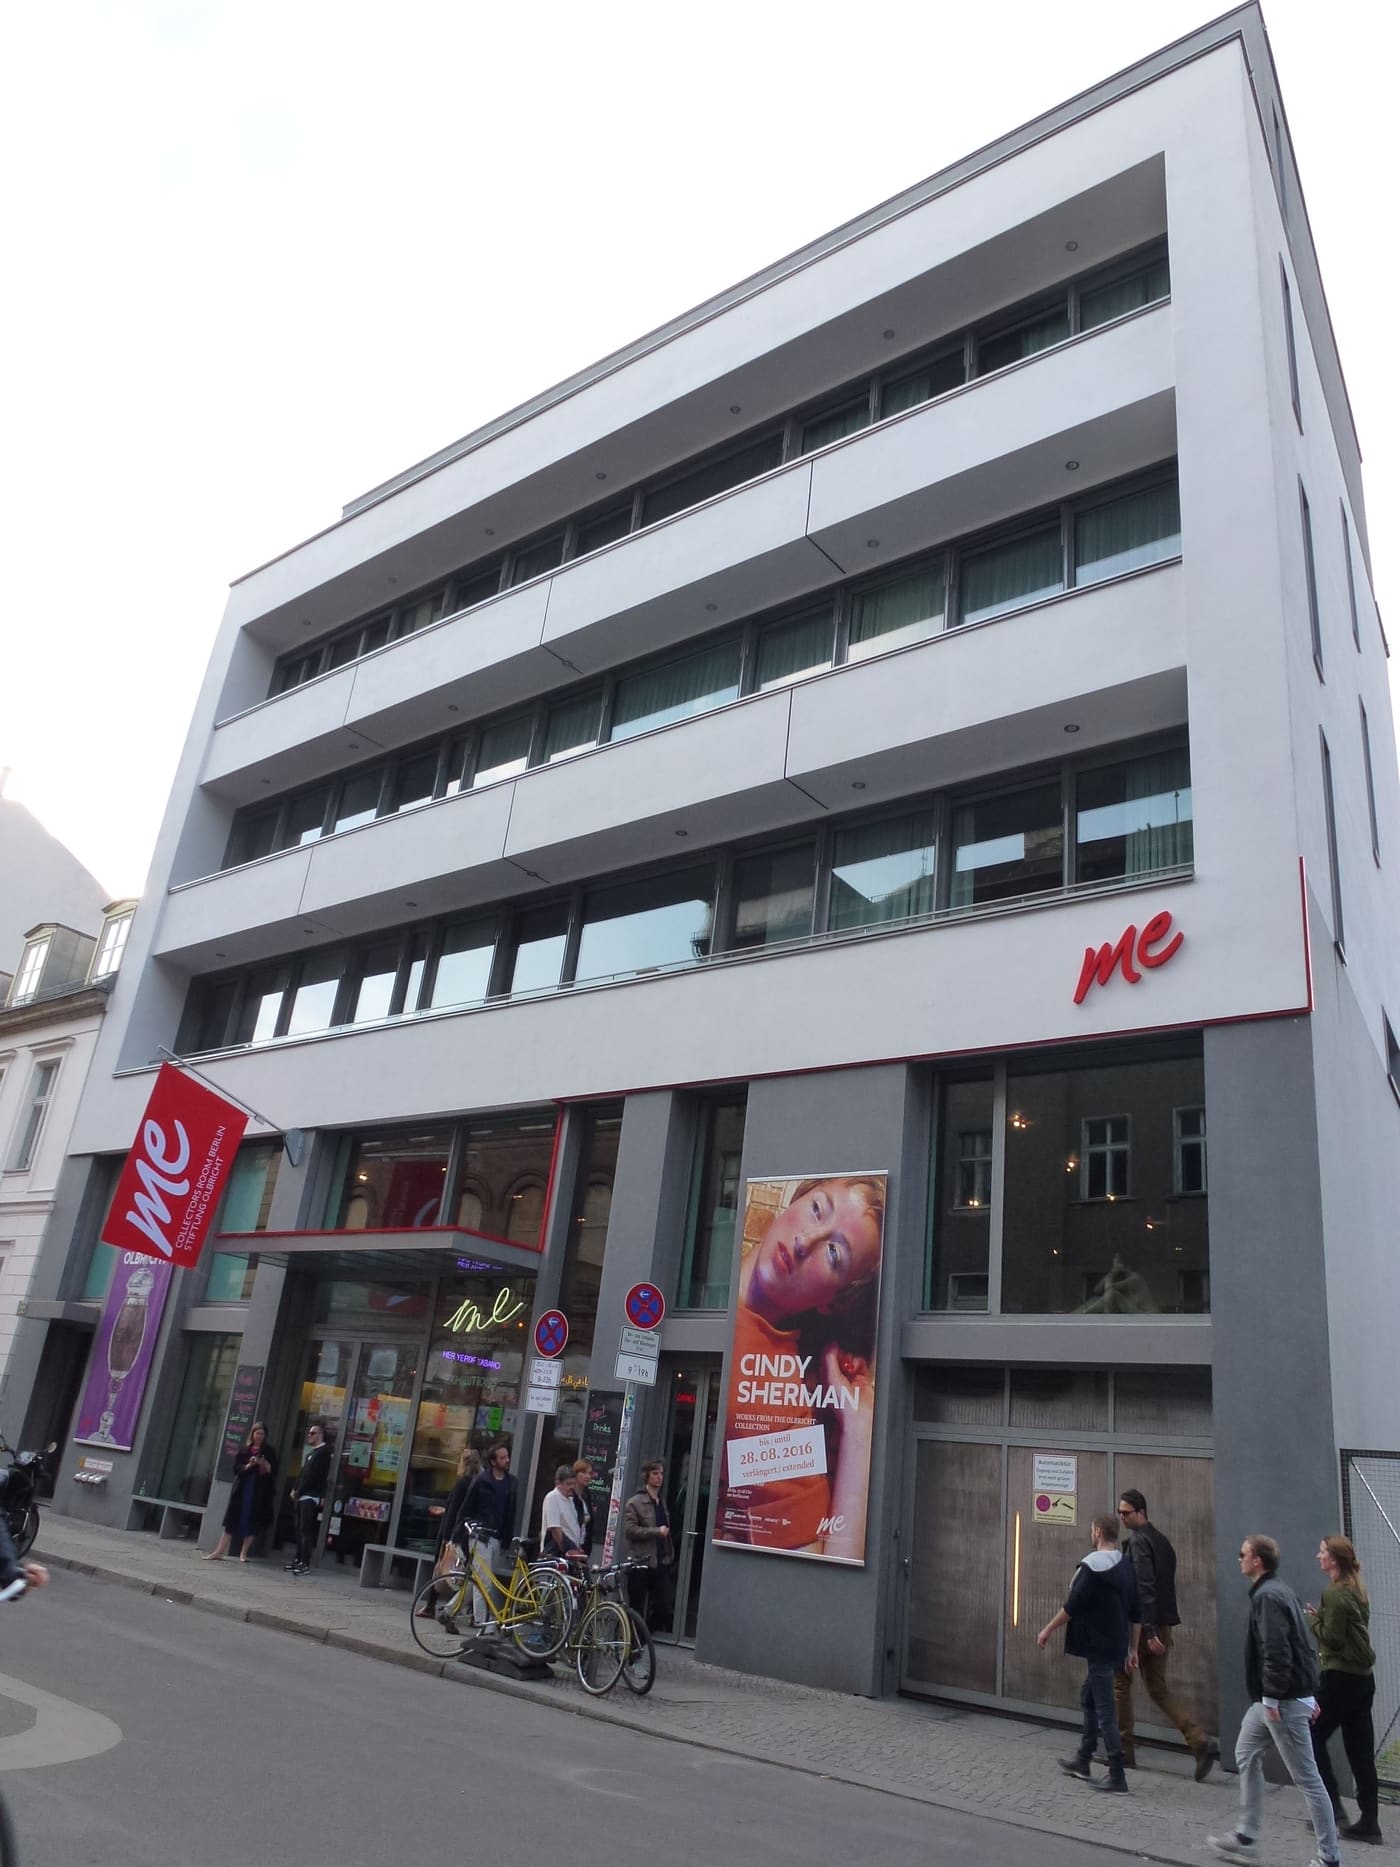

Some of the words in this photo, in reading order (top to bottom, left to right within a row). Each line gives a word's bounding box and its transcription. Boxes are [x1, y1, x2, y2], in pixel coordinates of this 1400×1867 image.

[1073, 911, 1184, 1005] me
[126, 1119, 190, 1258] me
[175, 1189, 201, 1249] COLLECTORS
[198, 1158, 214, 1189] ROOM
[207, 1125, 226, 1159] BERLIN
[184, 1202, 208, 1251] STIFTUNG
[203, 1156, 224, 1203] OLBRICHT
[443, 1287, 524, 1332] me
[442, 1350, 456, 1360] HER
[740, 1353, 812, 1379] CINDY
[737, 1381, 860, 1411] SHERMAN
[735, 1423, 770, 1431] COLLECTION
[736, 1413, 756, 1421] WORKS
[756, 1415, 774, 1423] FROM
[786, 1417, 816, 1425] OLBRICHT
[759, 1438, 770, 1446] bis
[774, 1434, 791, 1444] until
[742, 1466, 777, 1478] verlängert
[782, 1459, 815, 1472] extended
[816, 1515, 846, 1535] me
